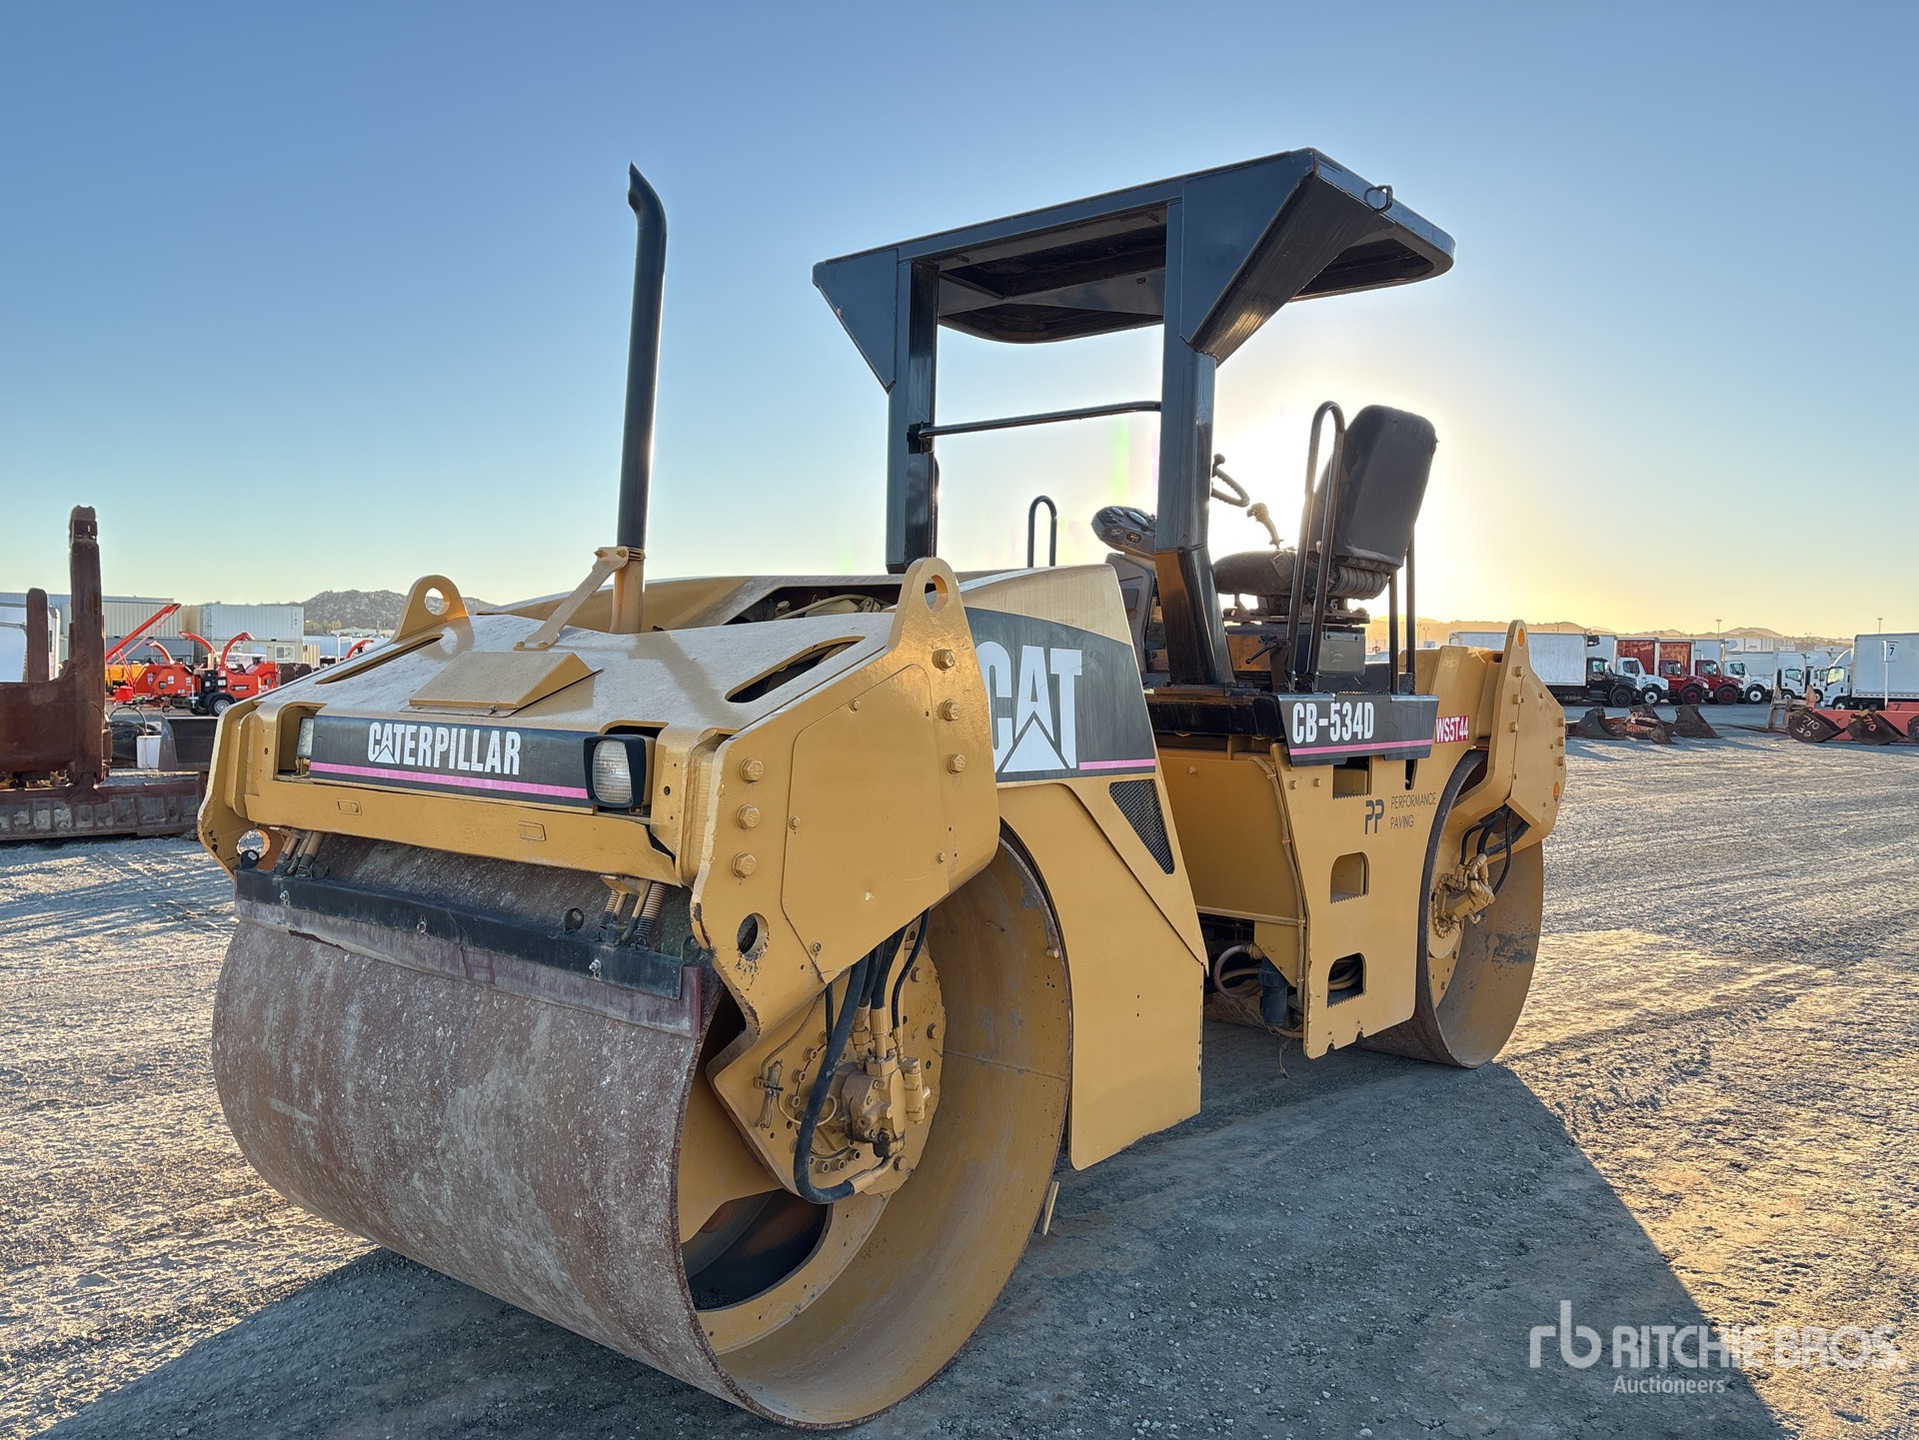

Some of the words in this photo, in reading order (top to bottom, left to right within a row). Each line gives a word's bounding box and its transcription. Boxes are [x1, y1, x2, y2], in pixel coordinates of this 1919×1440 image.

[1889, 646, 1895, 656] 7
[974, 641, 1082, 774] CAT
[1292, 701, 1375, 744] CB-534D
[1435, 716, 1469, 743] WS5T44
[367, 721, 521, 776] CATERPILLAR
[1364, 798, 1385, 835] PP
[1390, 791, 1437, 810] PERFORMANCE
[1390, 814, 1415, 830] PAVING
